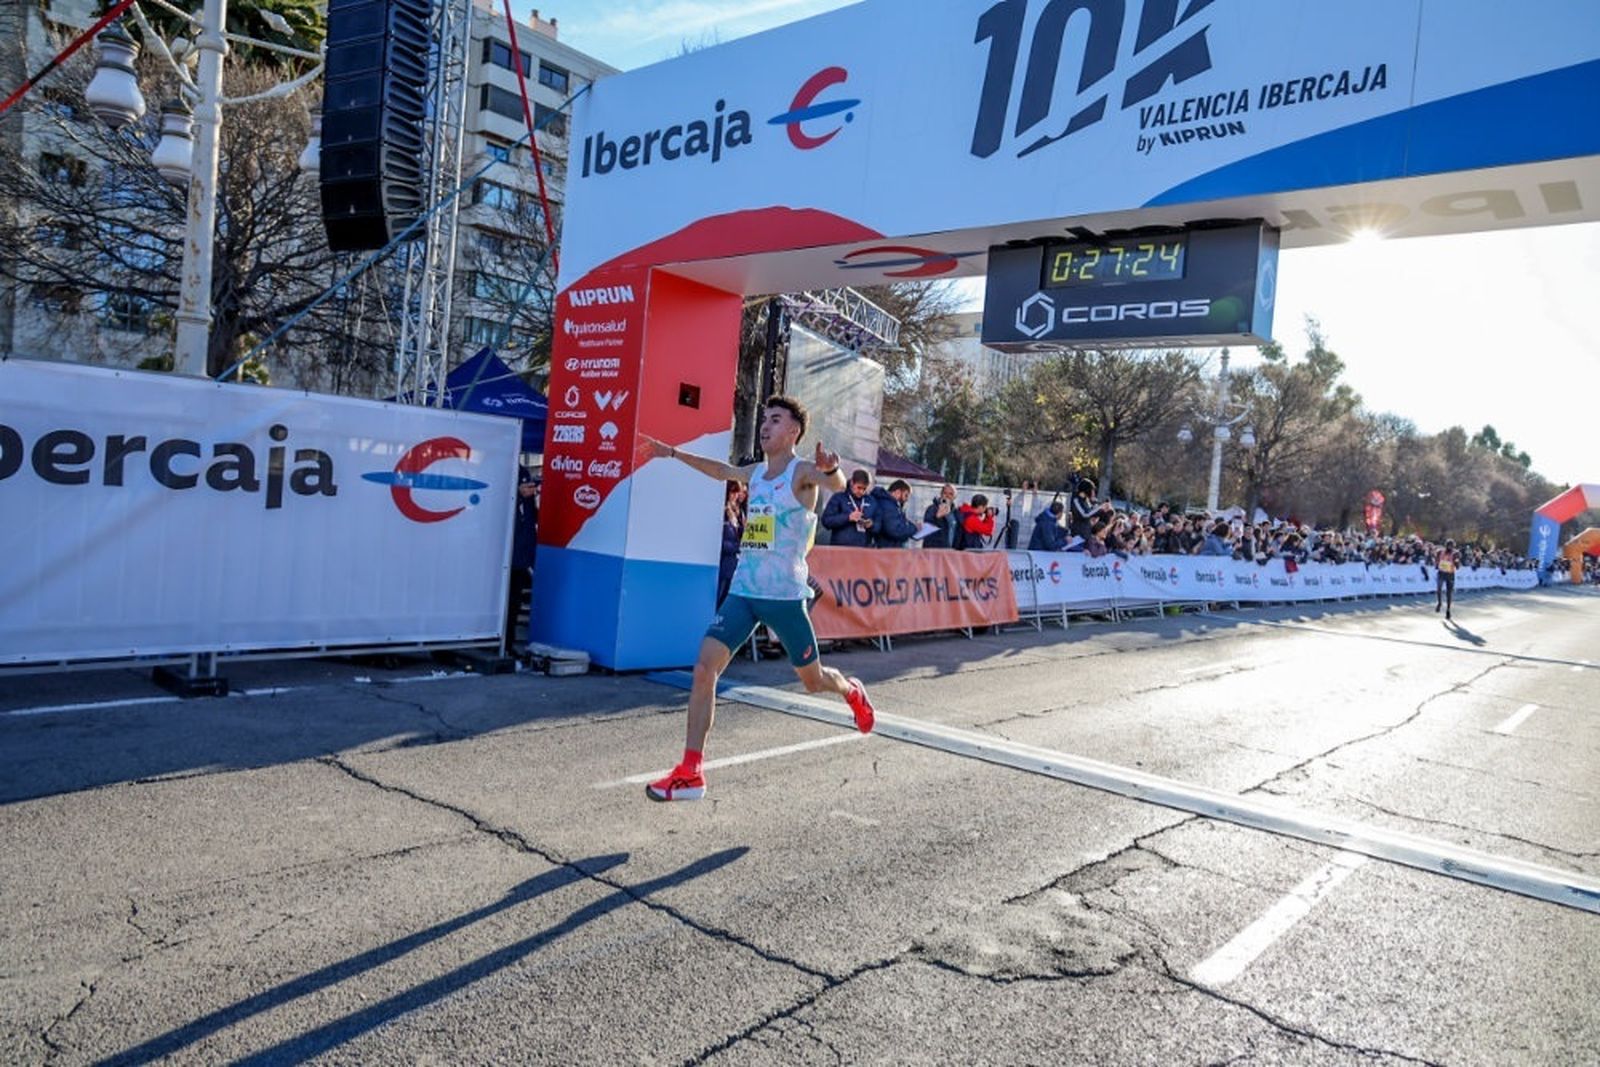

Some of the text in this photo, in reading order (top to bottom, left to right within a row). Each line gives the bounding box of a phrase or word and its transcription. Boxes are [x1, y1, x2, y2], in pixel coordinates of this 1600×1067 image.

[970, 0, 1215, 159] 10K
[1139, 63, 1388, 130] VALENCIA IBERCAJA
[581, 99, 752, 178] Ibercaja
[1136, 121, 1246, 153] by KIPRUN
[1051, 242, 1181, 283] 0:27:24
[568, 285, 634, 308] KIPRUN
[1062, 299, 1211, 324] COROS
[581, 358, 620, 369] HYUNDAI
[551, 455, 583, 472] divina
[829, 576, 999, 608] WORLD ATHLETICS
